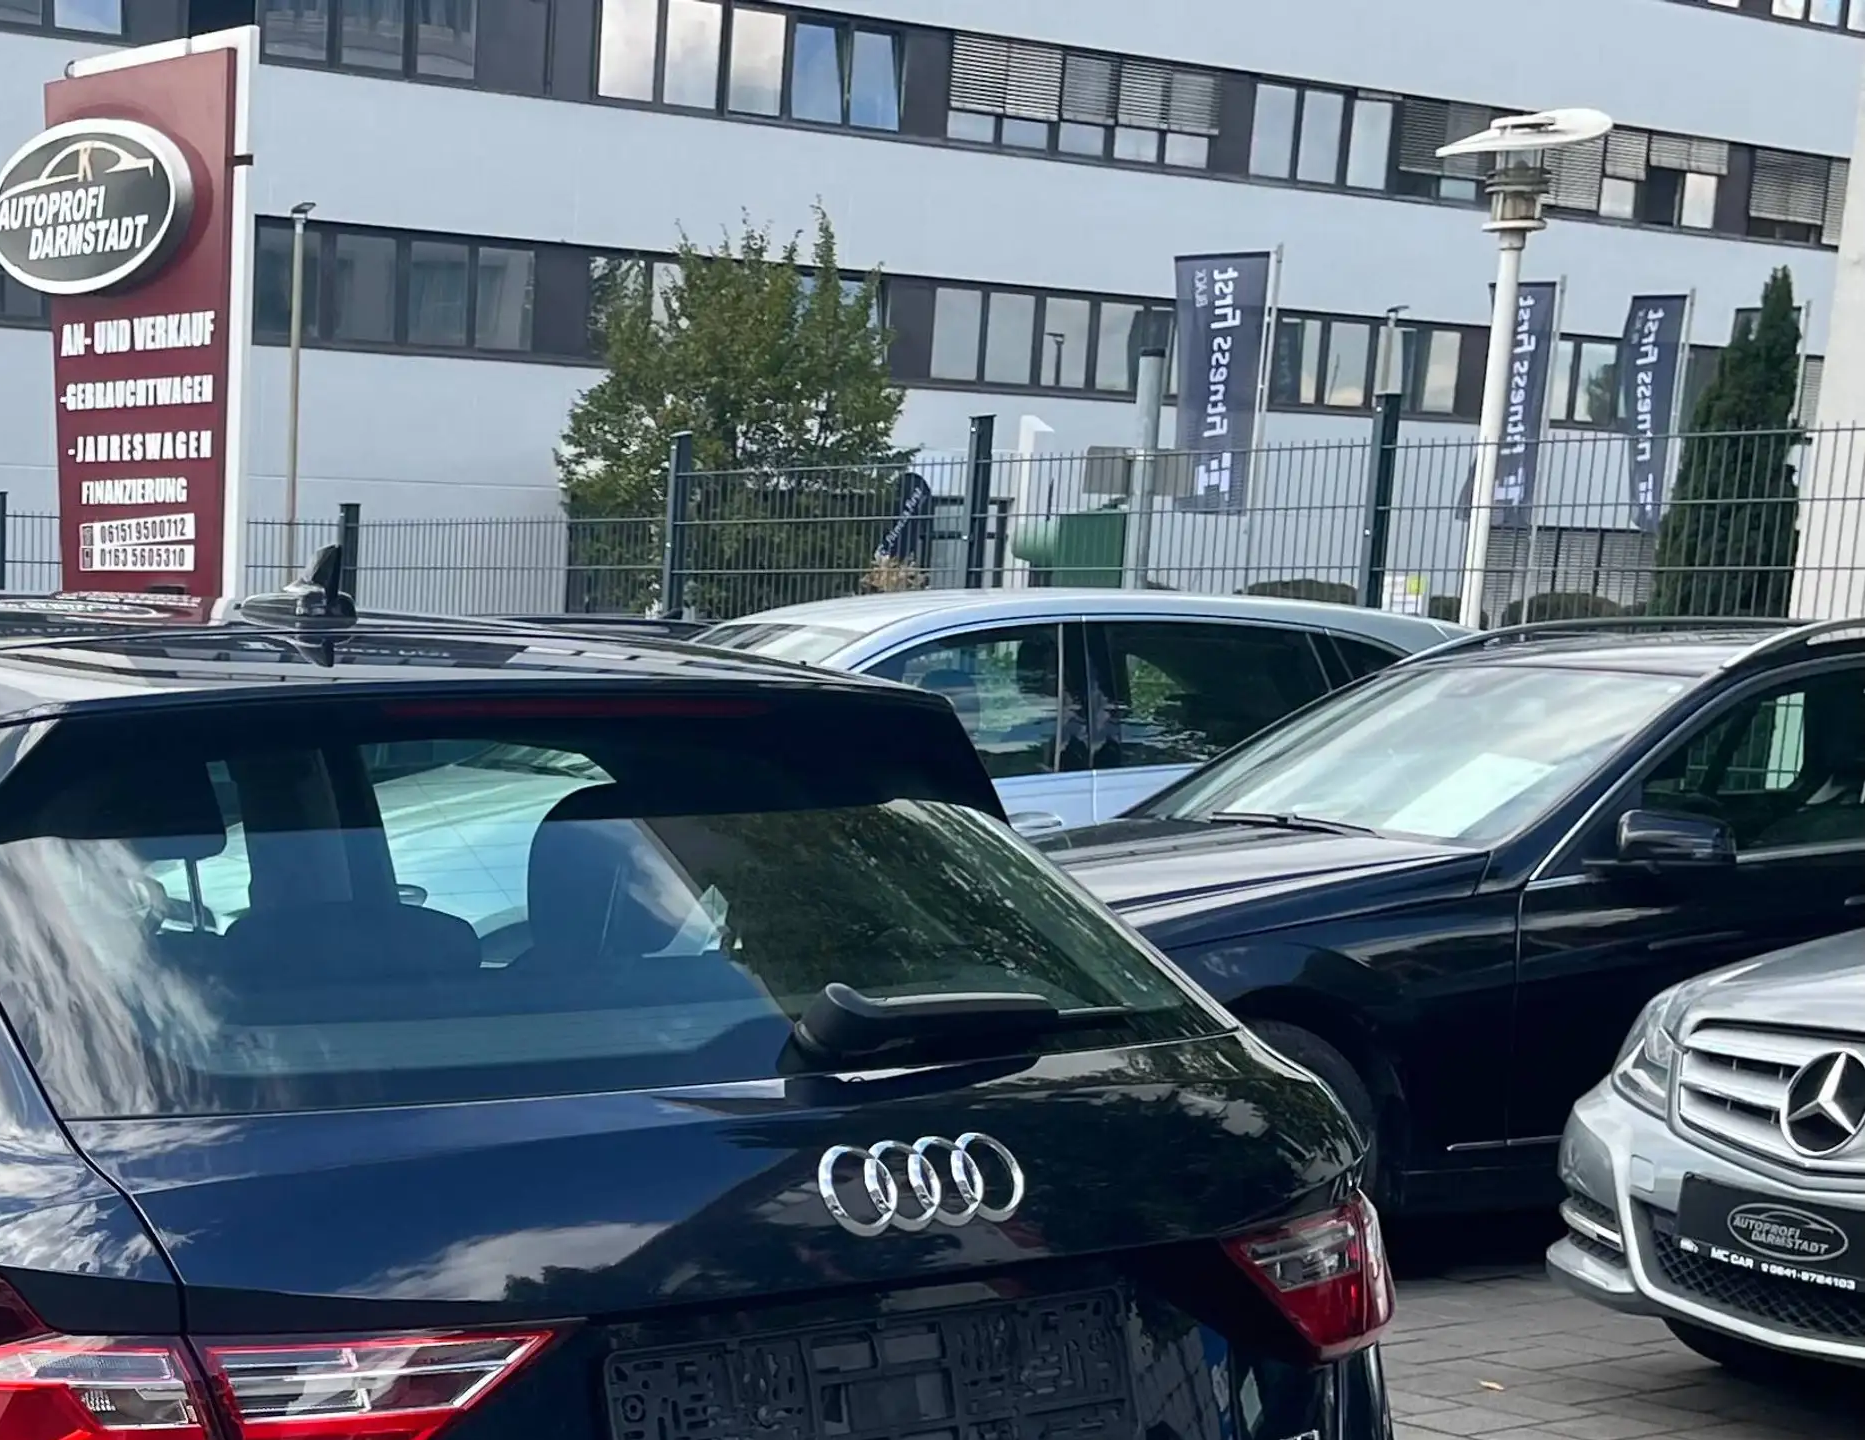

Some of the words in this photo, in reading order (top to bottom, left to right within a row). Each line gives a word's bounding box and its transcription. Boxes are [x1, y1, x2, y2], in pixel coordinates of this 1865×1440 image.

[28, 215, 149, 260] DARMSTADT
[61, 323, 92, 357] AN-
[93, 319, 131, 354] UND
[133, 311, 215, 351] VERKAUF
[81, 477, 188, 505] FINANZIERUNG
[100, 524, 132, 544] 06151
[135, 517, 186, 541] 9500712
[100, 548, 128, 567] 0163
[131, 547, 185, 567] 5605310
[1733, 1215, 1801, 1239] AUTOPROFI
[1751, 1230, 1830, 1255] DARMSTADT
[1730, 1254, 1754, 1269] CAR
